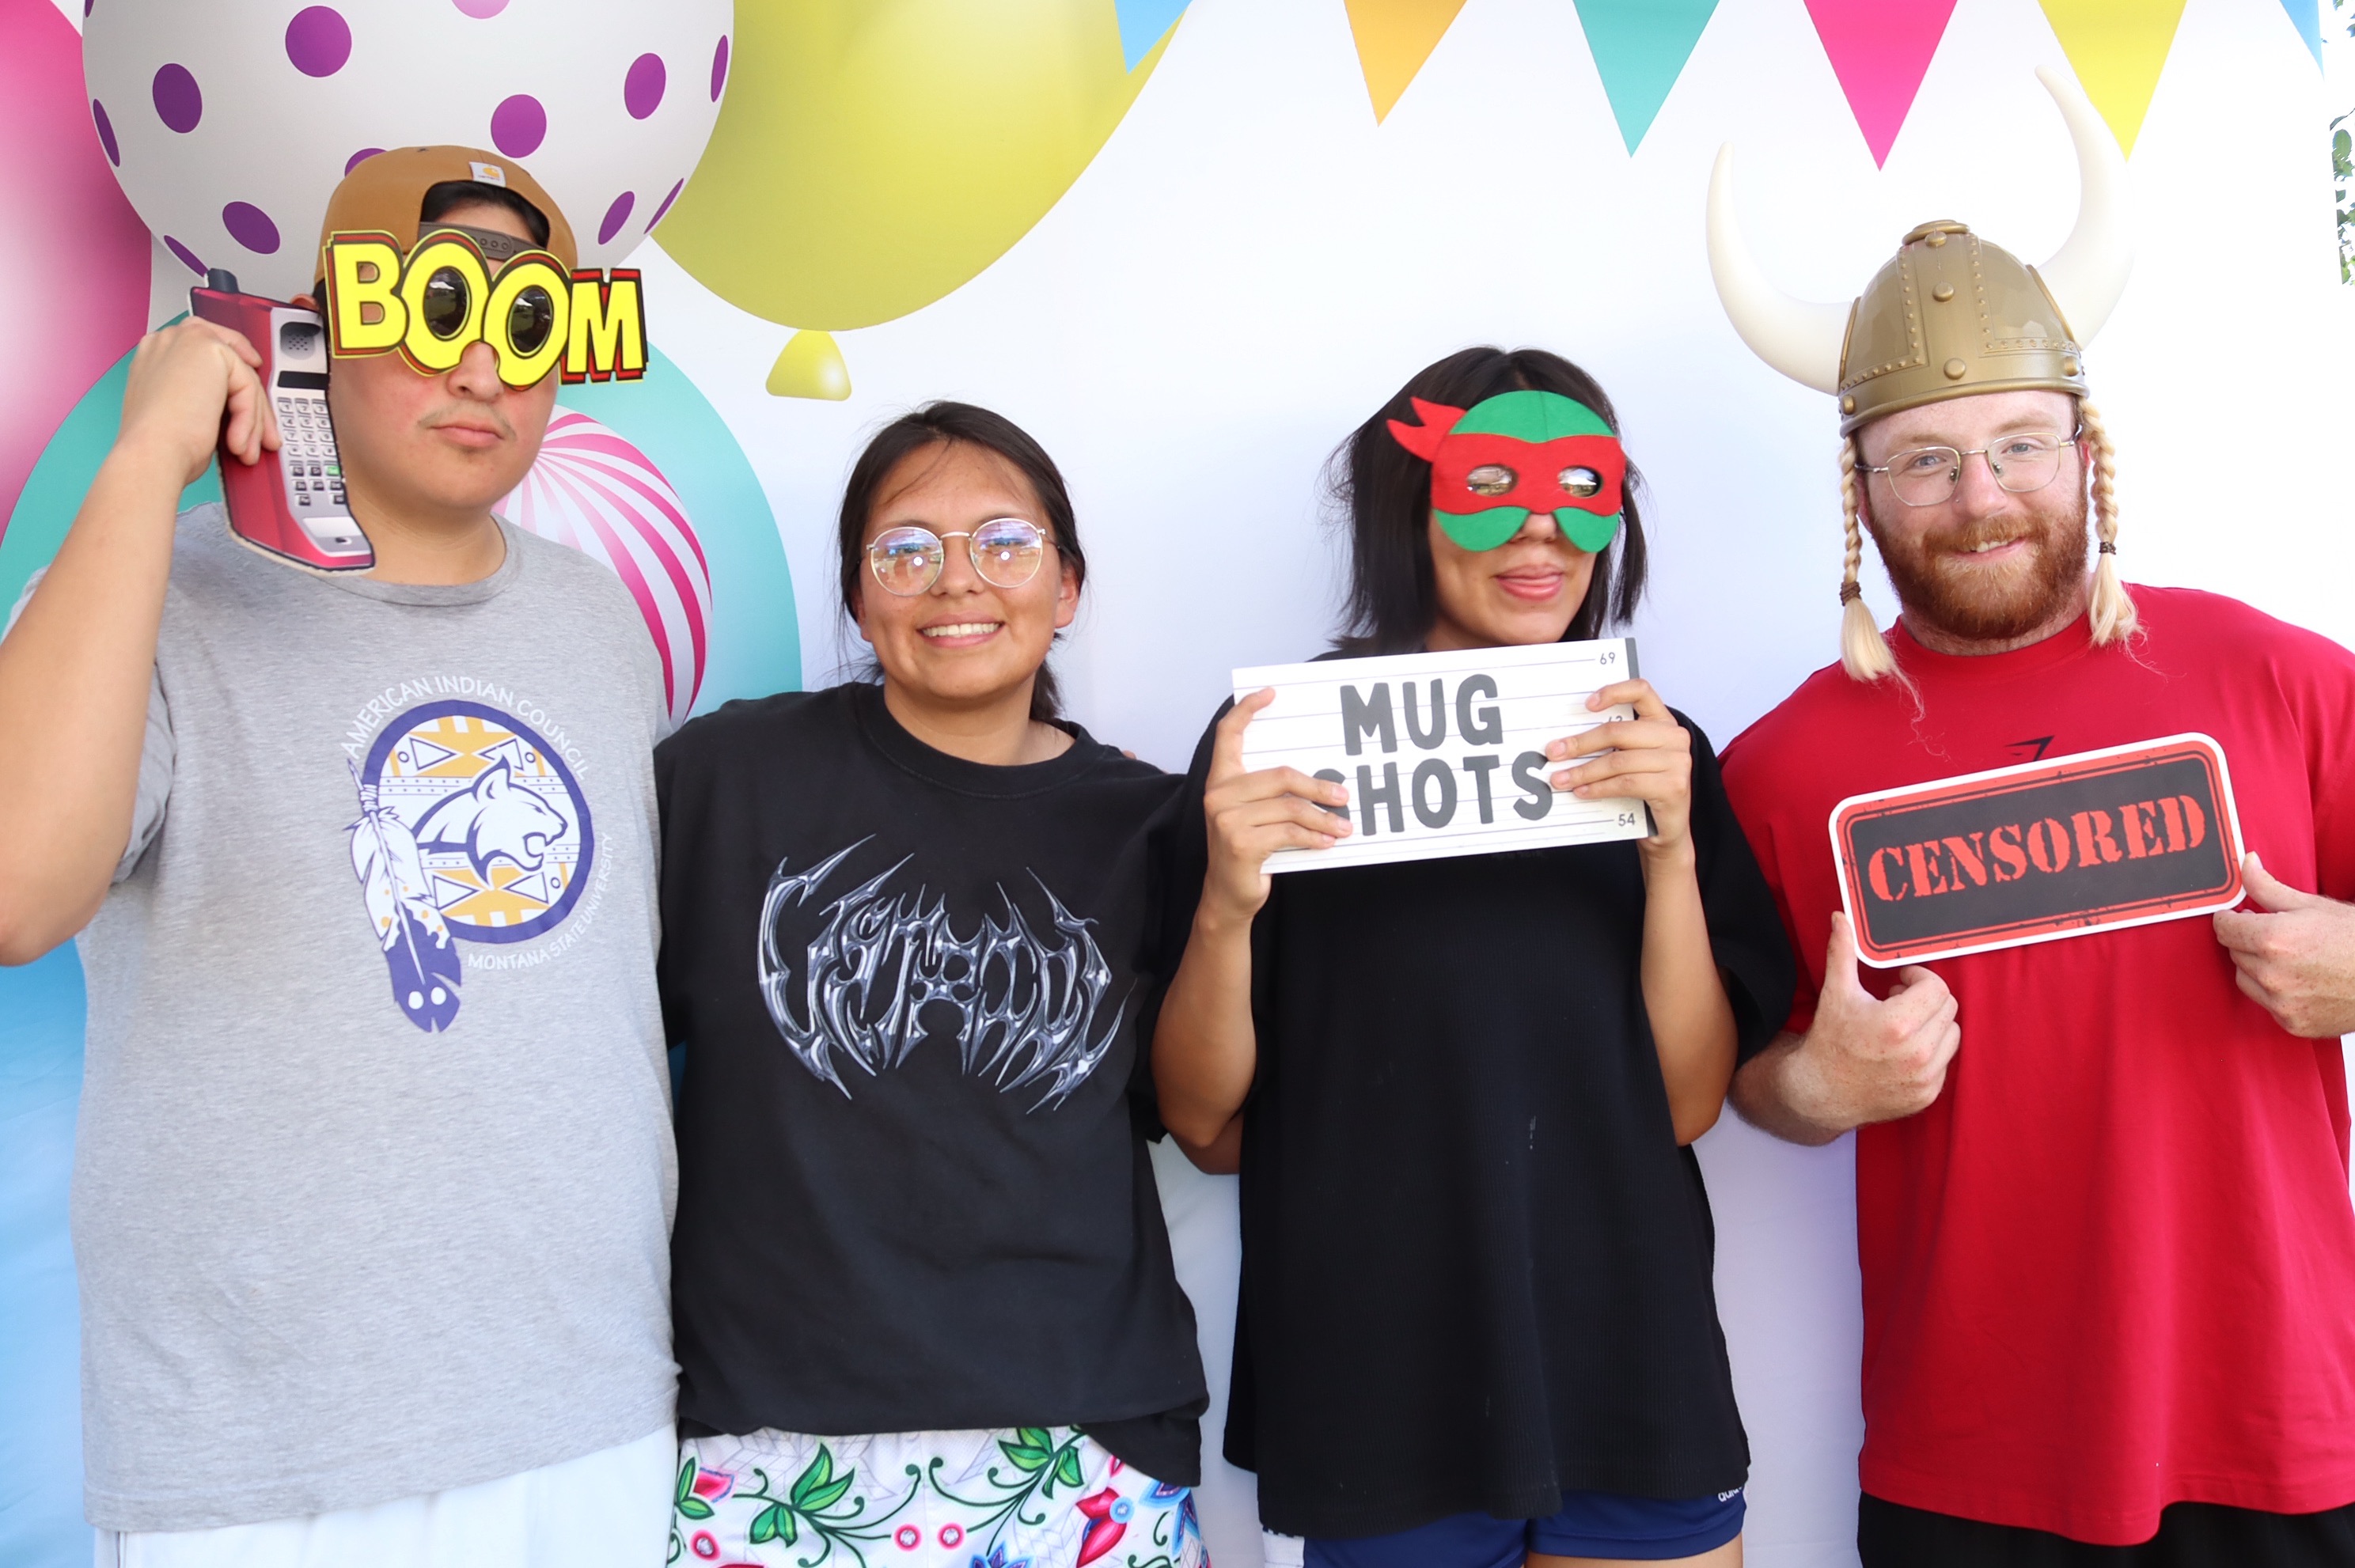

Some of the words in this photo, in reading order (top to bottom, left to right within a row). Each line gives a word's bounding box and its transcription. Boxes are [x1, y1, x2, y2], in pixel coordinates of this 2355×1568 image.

[323, 229, 649, 391] BOOM
[1600, 652, 1616, 665] 69
[340, 676, 434, 759] AMERICAN
[434, 675, 514, 707] INDIAN
[516, 699, 590, 781] COUNCIL
[1340, 673, 1503, 756] MUG
[1618, 812, 1636, 827] 54
[1868, 793, 2207, 902] CENSORED
[468, 949, 551, 971] MONTANA
[549, 920, 586, 956] STATE
[580, 832, 613, 925] UNIVERSITY
